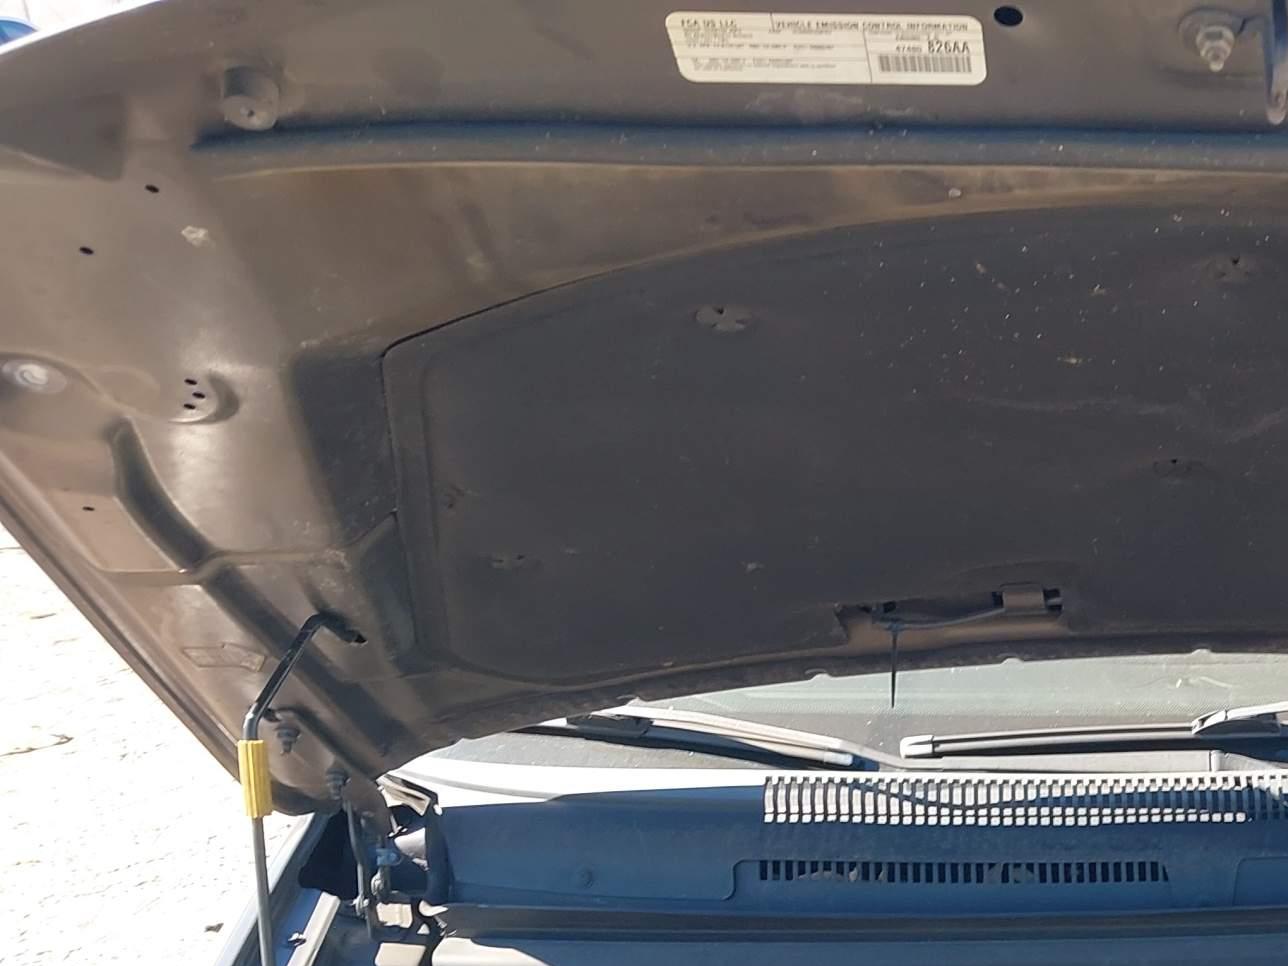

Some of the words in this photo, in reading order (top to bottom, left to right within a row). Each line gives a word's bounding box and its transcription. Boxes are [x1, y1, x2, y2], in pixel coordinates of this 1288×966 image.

[776, 20, 812, 31] VEHICLE
[815, 20, 859, 31] EMISSION
[862, 21, 903, 32] CONTROL
[906, 22, 969, 32] INFORMATION
[927, 40, 971, 55] 826AA
